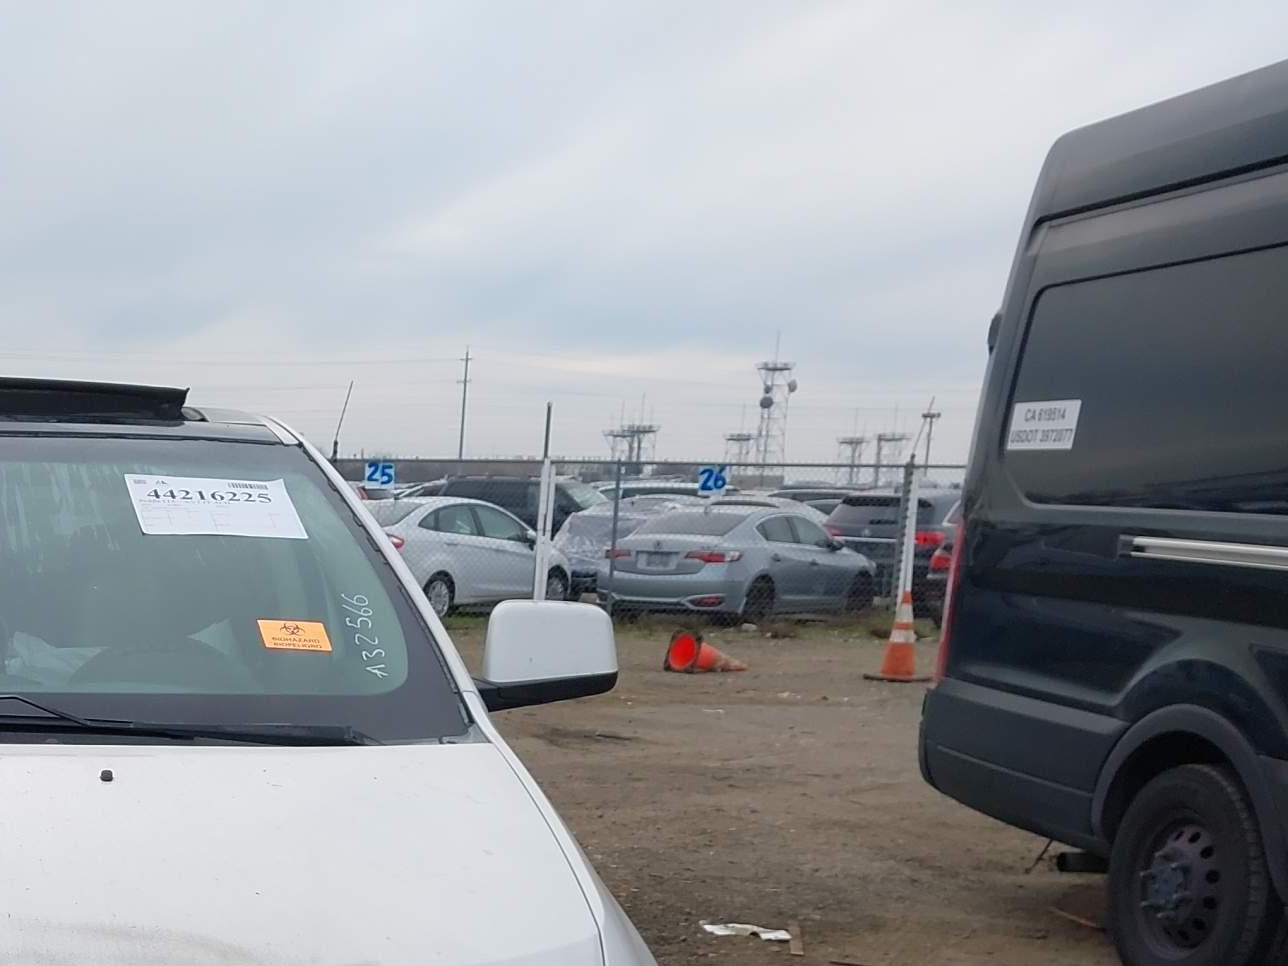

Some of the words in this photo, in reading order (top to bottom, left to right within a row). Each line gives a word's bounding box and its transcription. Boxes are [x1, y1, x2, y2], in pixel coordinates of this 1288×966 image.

[1024, 408, 1037, 421] CA
[1010, 428, 1039, 443] USDOT
[367, 462, 393, 485] 25
[699, 466, 726, 491] 26
[147, 488, 272, 504] 44216225
